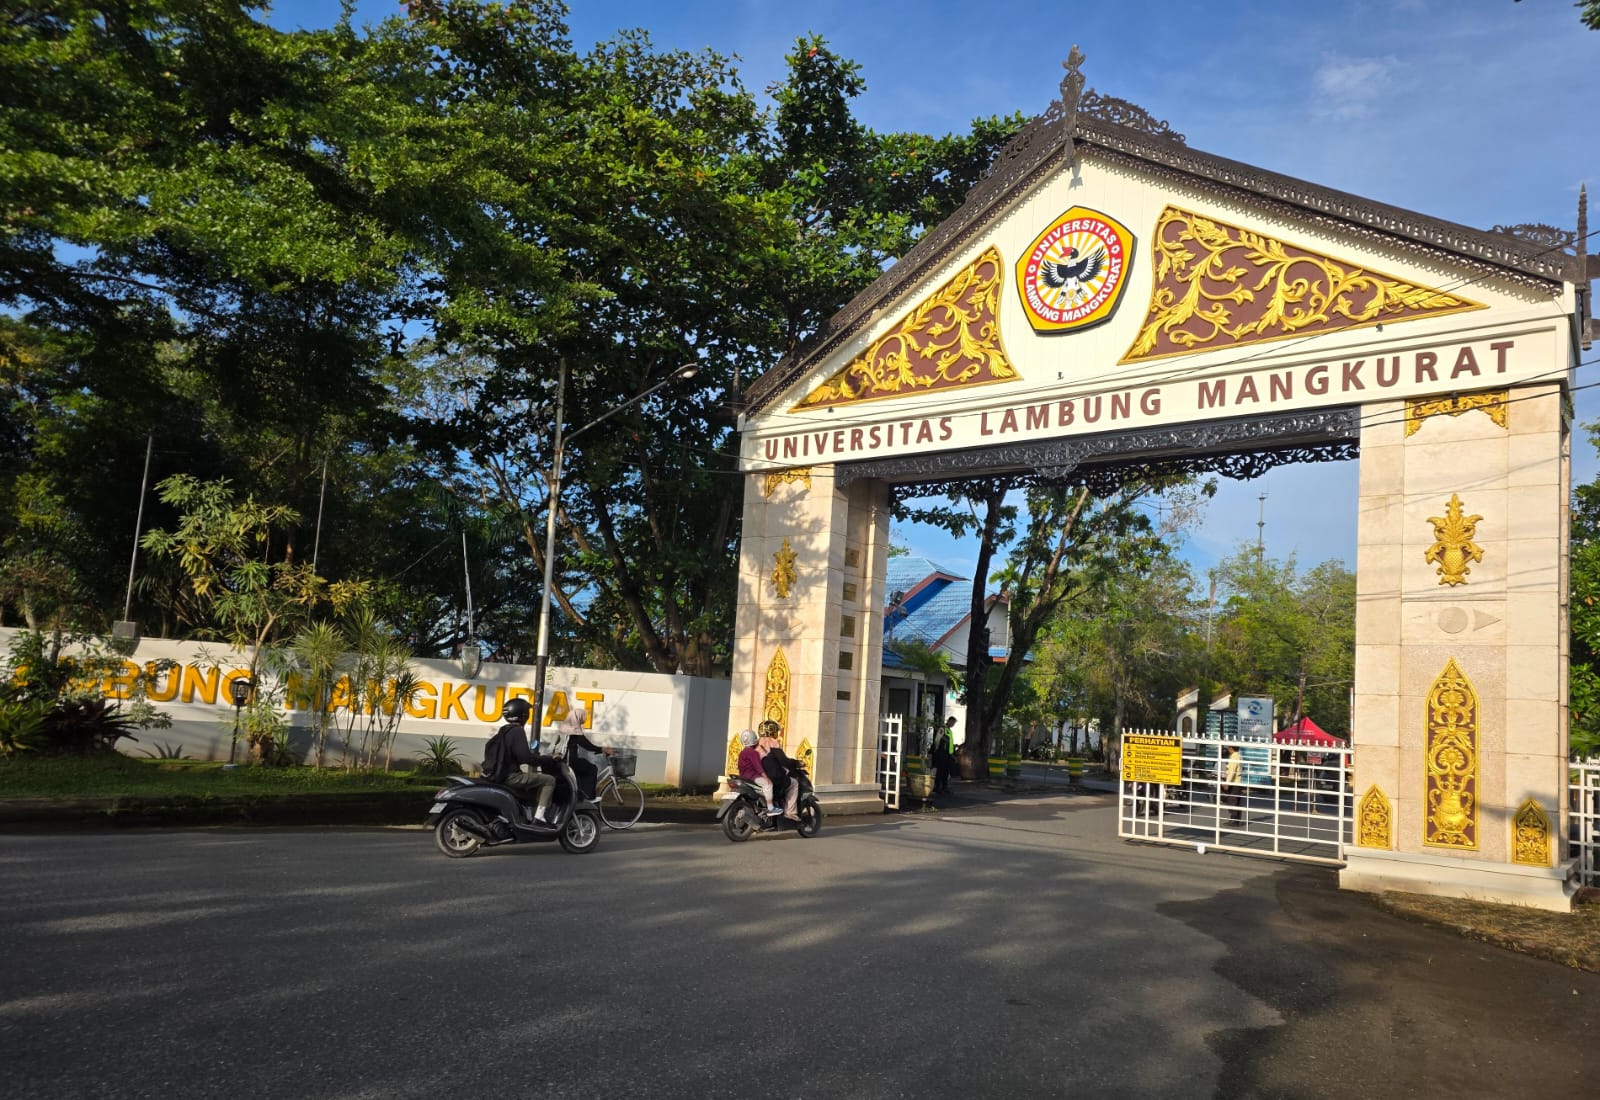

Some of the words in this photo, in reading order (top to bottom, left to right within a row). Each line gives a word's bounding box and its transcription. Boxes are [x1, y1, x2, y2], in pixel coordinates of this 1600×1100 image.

[1032, 219, 1117, 261] UNIVERSITAS
[1025, 275, 1060, 321] LAMBUNG
[1061, 258, 1122, 322] MANGKURAT
[765, 417, 952, 461] UNIVERSITAS
[980, 388, 1162, 437] LAMBUNG
[1198, 340, 1515, 410] MANGKURAT
[1129, 737, 1175, 746] PERHATIAN
